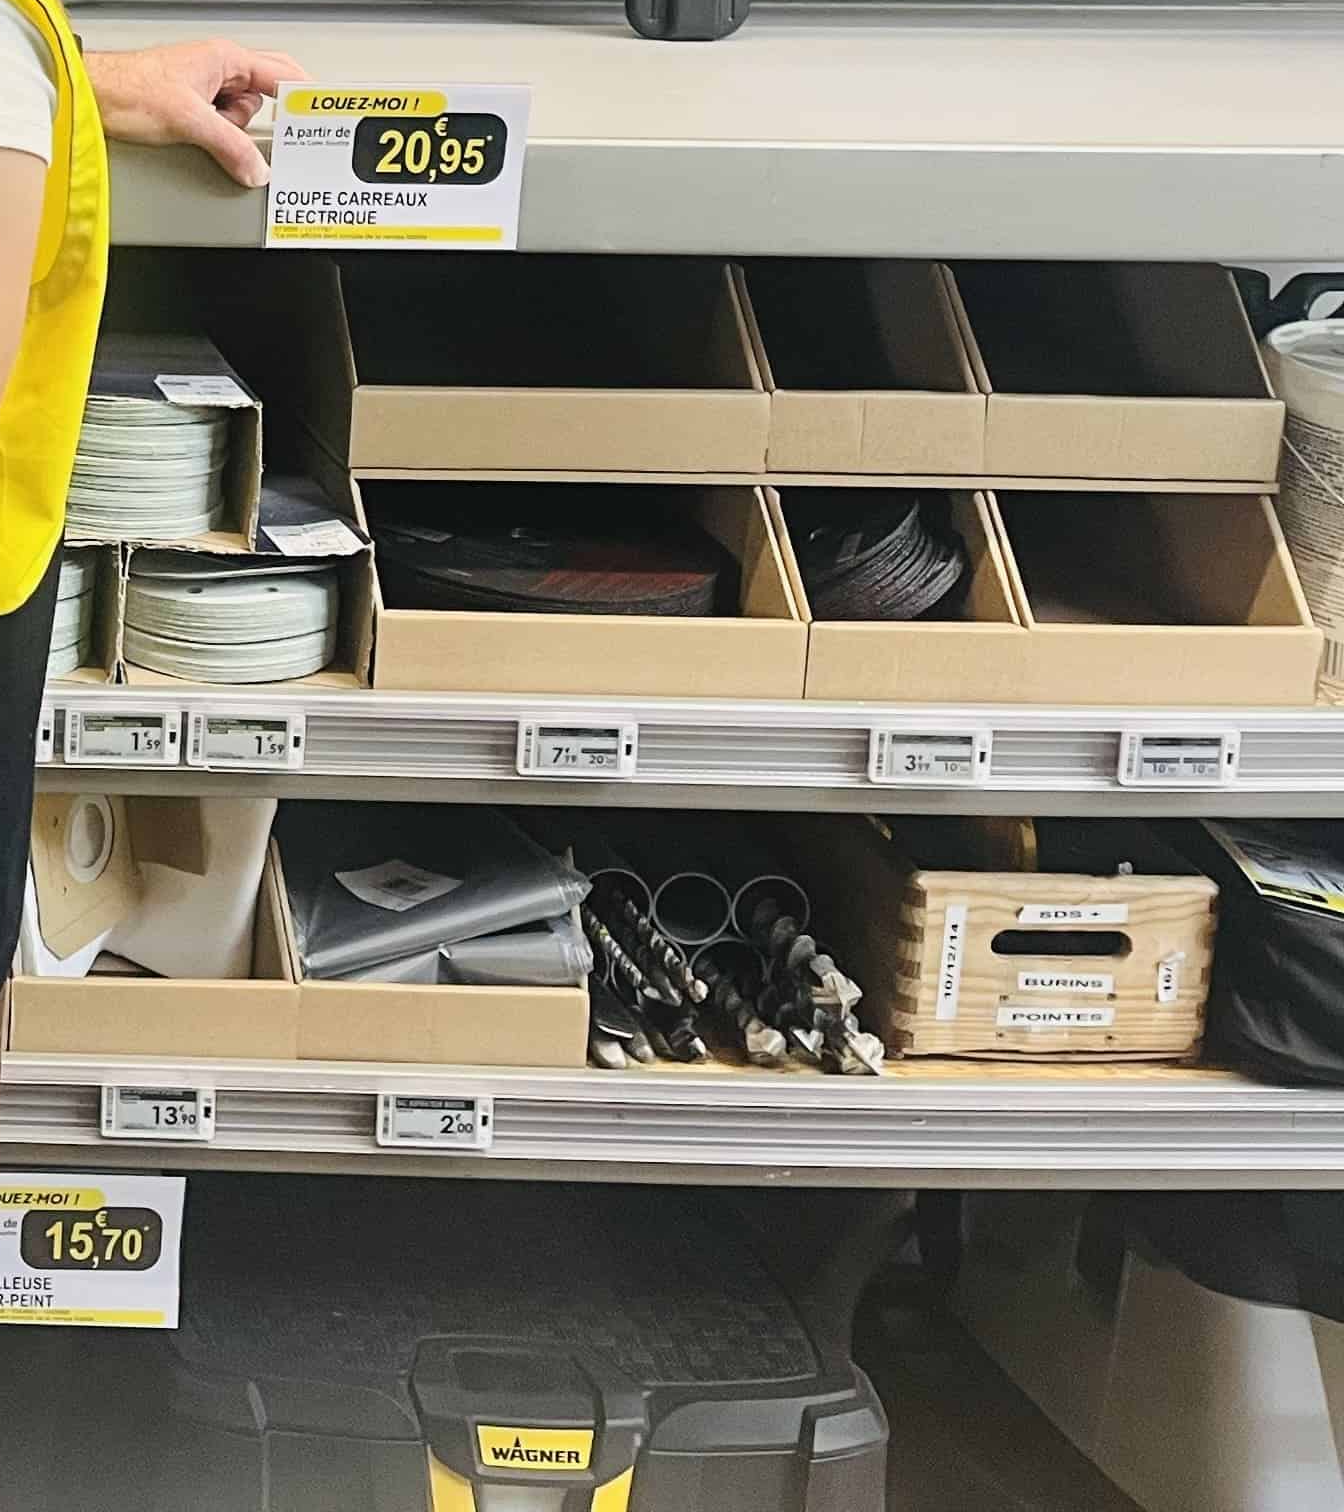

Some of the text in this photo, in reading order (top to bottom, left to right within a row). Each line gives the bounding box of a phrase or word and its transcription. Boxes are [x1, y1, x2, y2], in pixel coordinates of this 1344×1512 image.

[312, 97, 407, 110] LOUEZ-MOI
[297, 127, 331, 140] partir
[335, 126, 350, 137] de
[276, 192, 428, 206] COUPE CARREAUX
[1039, 910, 1082, 919] SDS
[943, 923, 959, 1000] 10/12/14
[1024, 978, 1103, 988] BURINS
[1012, 1013, 1103, 1022] POINTES
[4, 1219, 17, 1228] de
[491, 1443, 580, 1464] WAGNER
